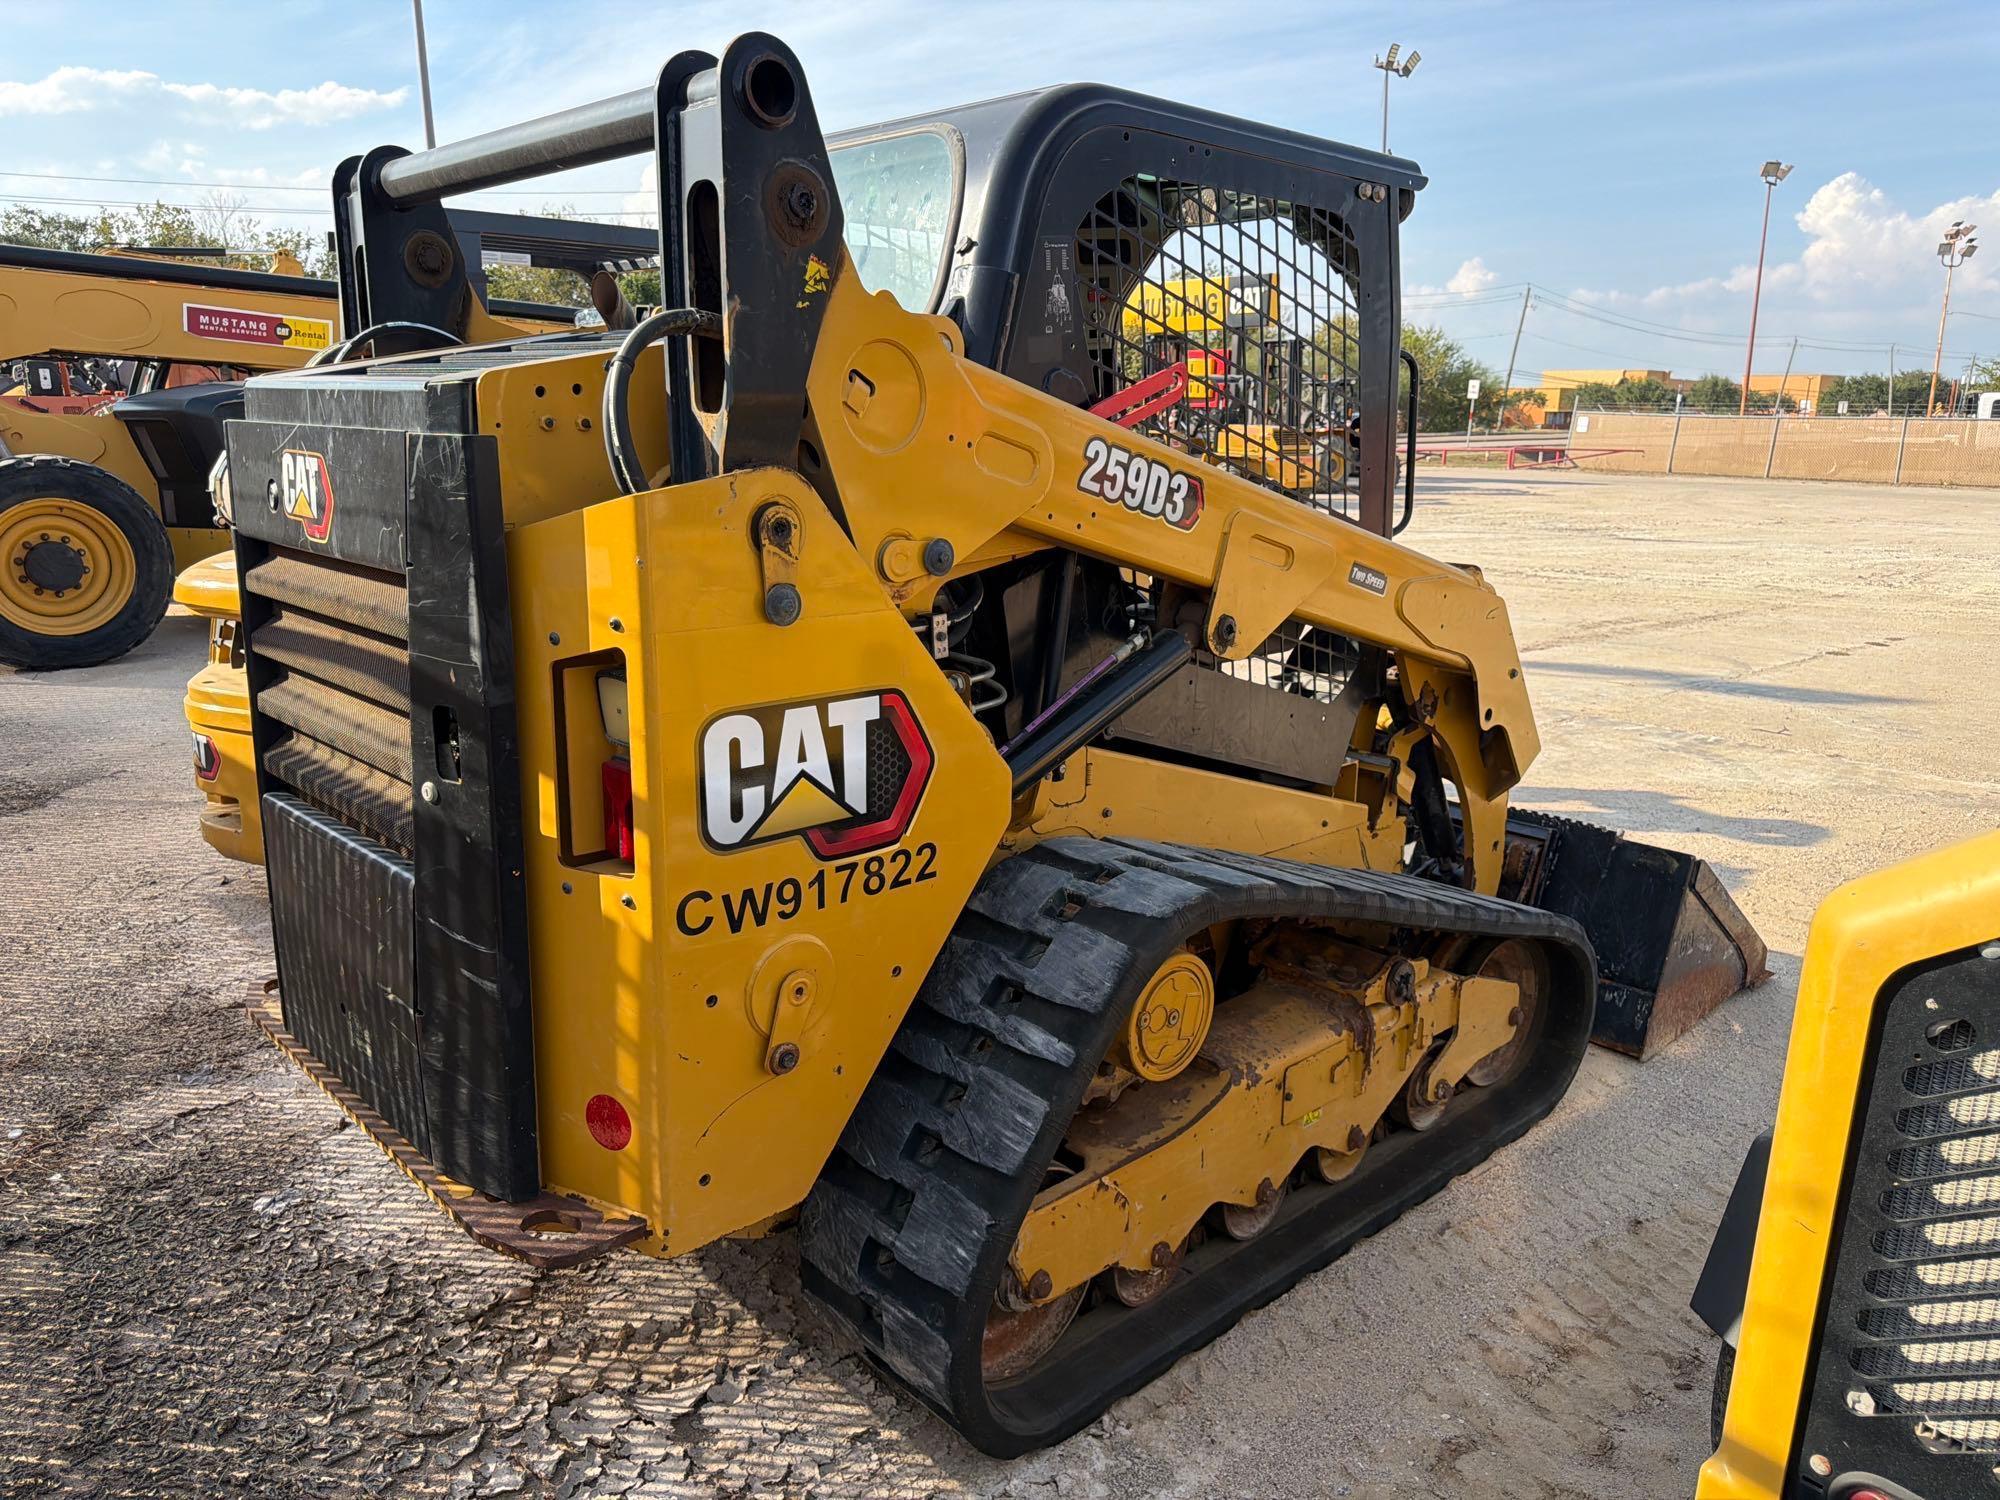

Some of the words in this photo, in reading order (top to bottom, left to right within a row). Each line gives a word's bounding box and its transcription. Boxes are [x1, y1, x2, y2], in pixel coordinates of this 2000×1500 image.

[199, 314, 268, 332] MUSTANG
[1229, 286, 1265, 315] CAT
[199, 324, 229, 333] RENTAL
[231, 327, 268, 338] SERVICES
[276, 326, 291, 337] CAT
[294, 329, 327, 341] Rental
[281, 452, 319, 520] CAT
[1080, 439, 1189, 523] 259D3
[703, 694, 881, 846] CAT
[675, 841, 938, 937] CW917822
